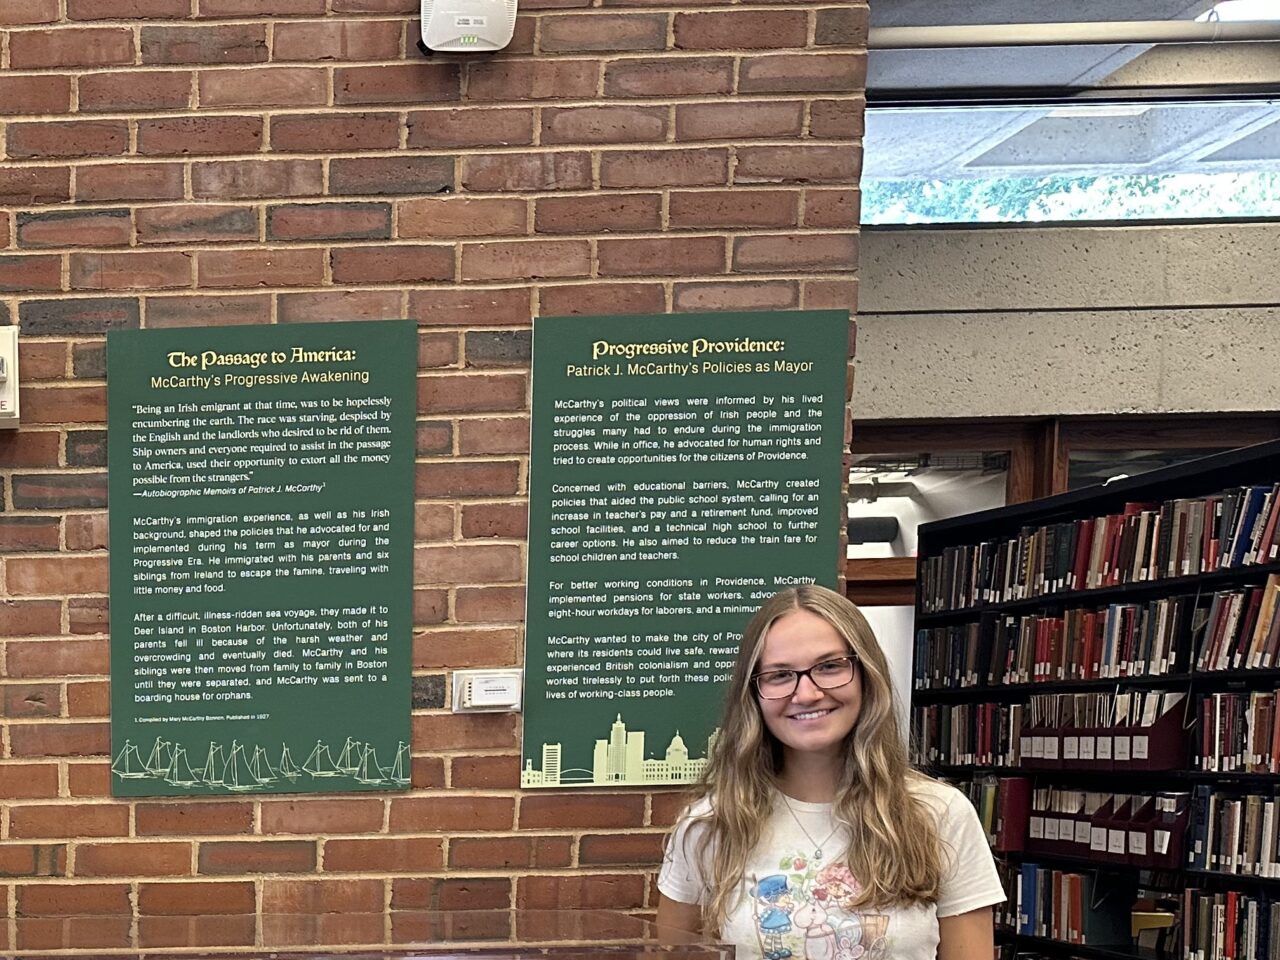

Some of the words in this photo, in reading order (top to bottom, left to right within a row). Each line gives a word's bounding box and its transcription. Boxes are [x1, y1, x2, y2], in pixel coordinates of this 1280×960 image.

[593, 339, 689, 360] Progressive
[167, 351, 198, 368] The
[201, 351, 268, 370] Passage
[271, 351, 287, 364] to
[567, 364, 611, 377] Patrick
[702, 361, 752, 374] Policies
[755, 362, 771, 373] as
[774, 360, 814, 375] Mayor
[225, 372, 298, 388] Progressive
[300, 370, 370, 384] Awakening
[178, 403, 199, 413] Irish
[200, 402, 241, 414] emigrant
[243, 402, 252, 411] at
[255, 401, 273, 410] that
[300, 400, 319, 408] was
[320, 400, 330, 408] to
[332, 398, 344, 407] be
[346, 396, 392, 409] hopelessly
[611, 398, 647, 409] political
[654, 398, 680, 407] views
[686, 398, 709, 406] were
[715, 396, 756, 405] informed
[763, 395, 775, 406] by
[781, 395, 795, 404] his
[802, 394, 823, 404] lived
[203, 487, 237, 496] Memoirs
[238, 486, 248, 495] of
[248, 485, 276, 494] Patrick
[549, 581, 564, 590] For
[570, 580, 598, 590] better
[604, 580, 640, 590] working
[646, 578, 693, 588] conditions
[700, 579, 709, 587] in
